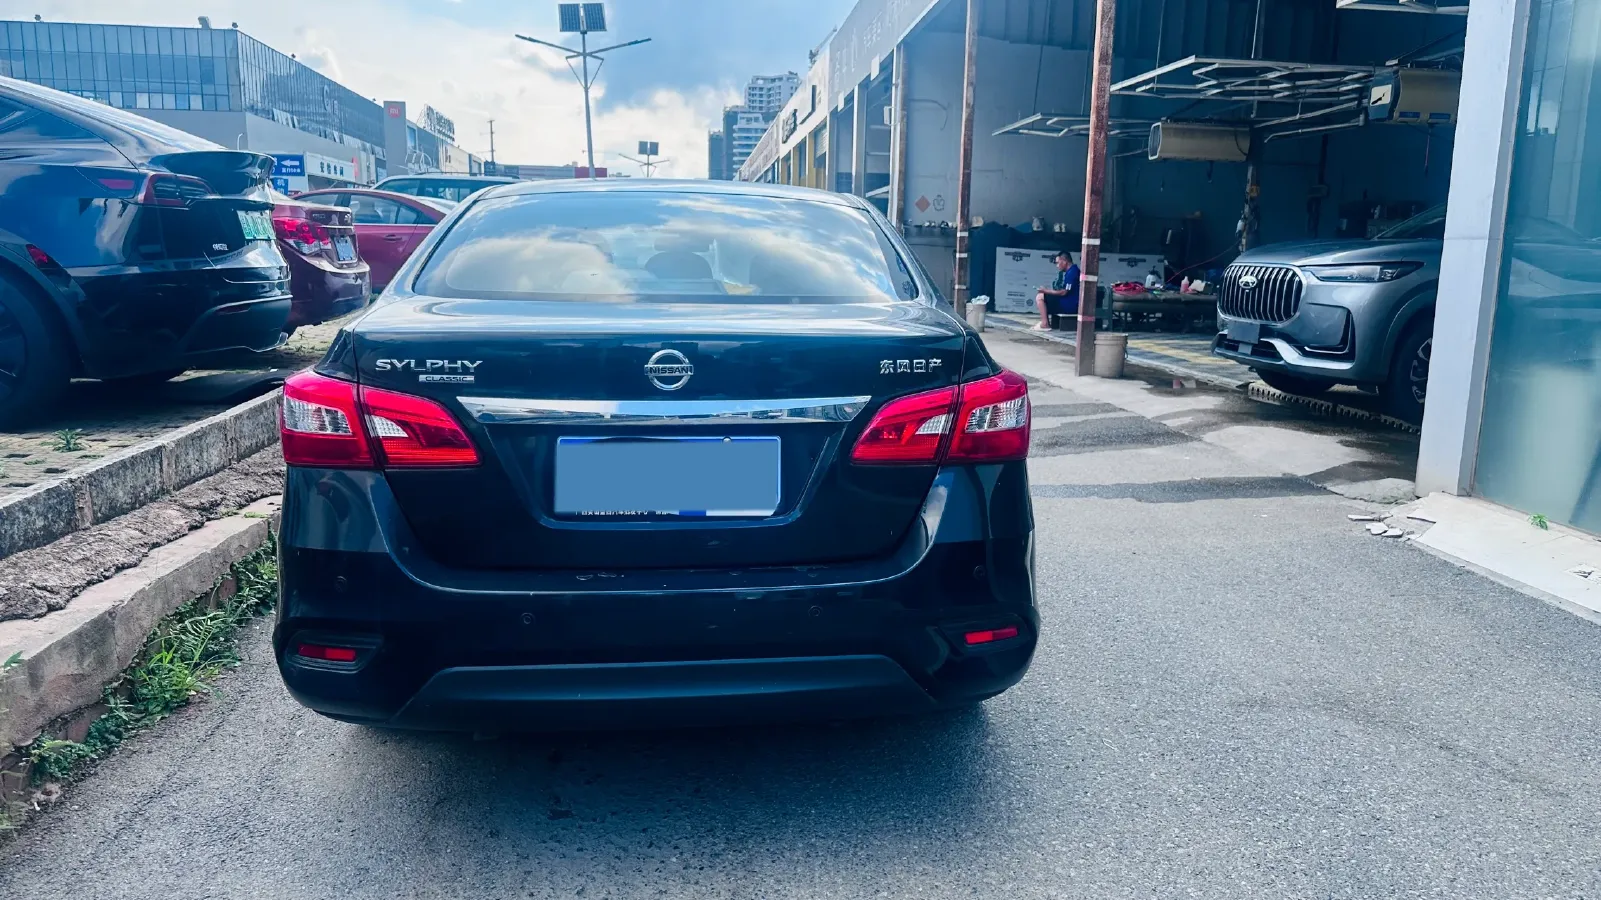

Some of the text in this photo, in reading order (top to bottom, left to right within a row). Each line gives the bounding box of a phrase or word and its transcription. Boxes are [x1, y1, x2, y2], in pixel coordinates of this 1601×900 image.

[375, 358, 483, 372] SYLPHY
[649, 366, 690, 375] NISSAN
[879, 358, 942, 374] 东风日产
